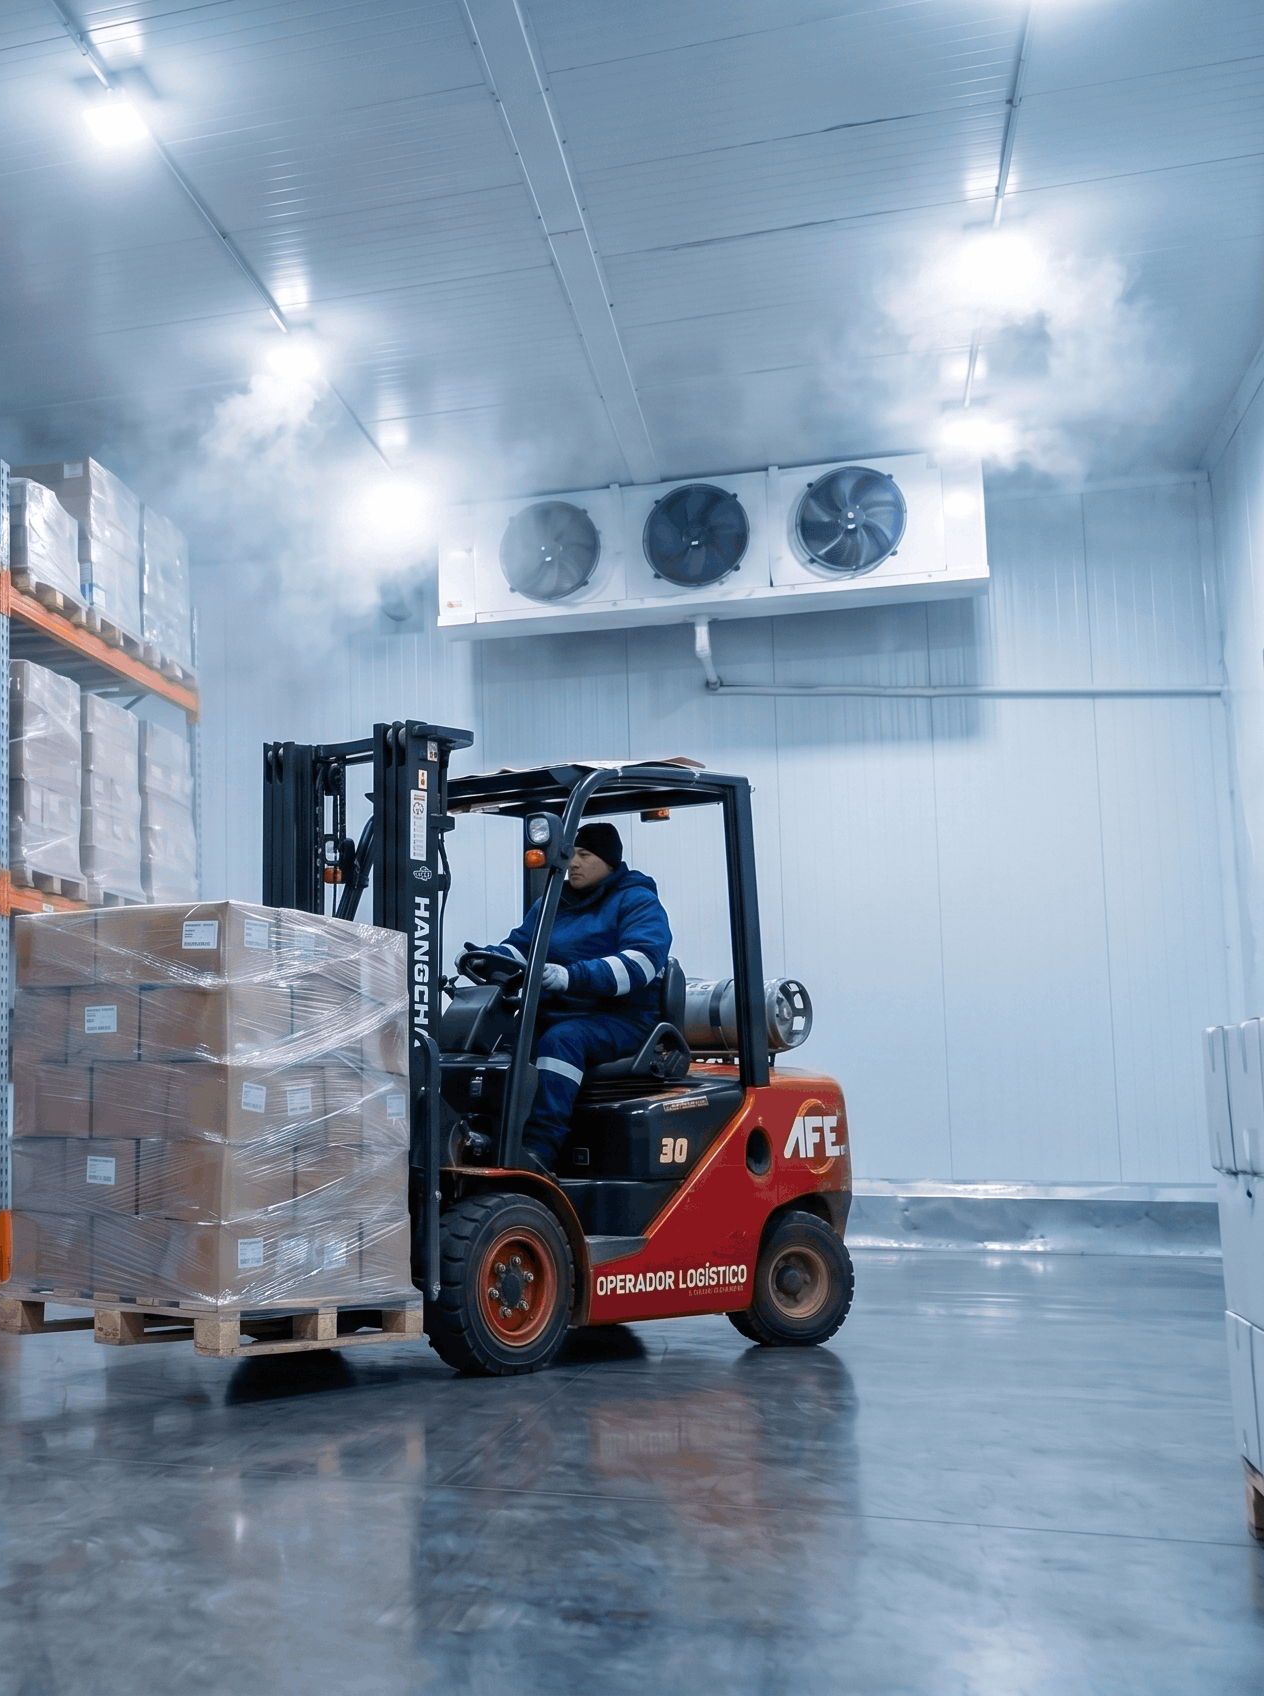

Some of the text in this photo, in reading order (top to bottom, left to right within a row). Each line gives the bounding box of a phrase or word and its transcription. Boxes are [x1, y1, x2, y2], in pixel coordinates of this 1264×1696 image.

[659, 1137, 688, 1163] 30
[596, 1270, 675, 1296] OPERADOR
[679, 1261, 747, 1288] LOGÍSTICO
